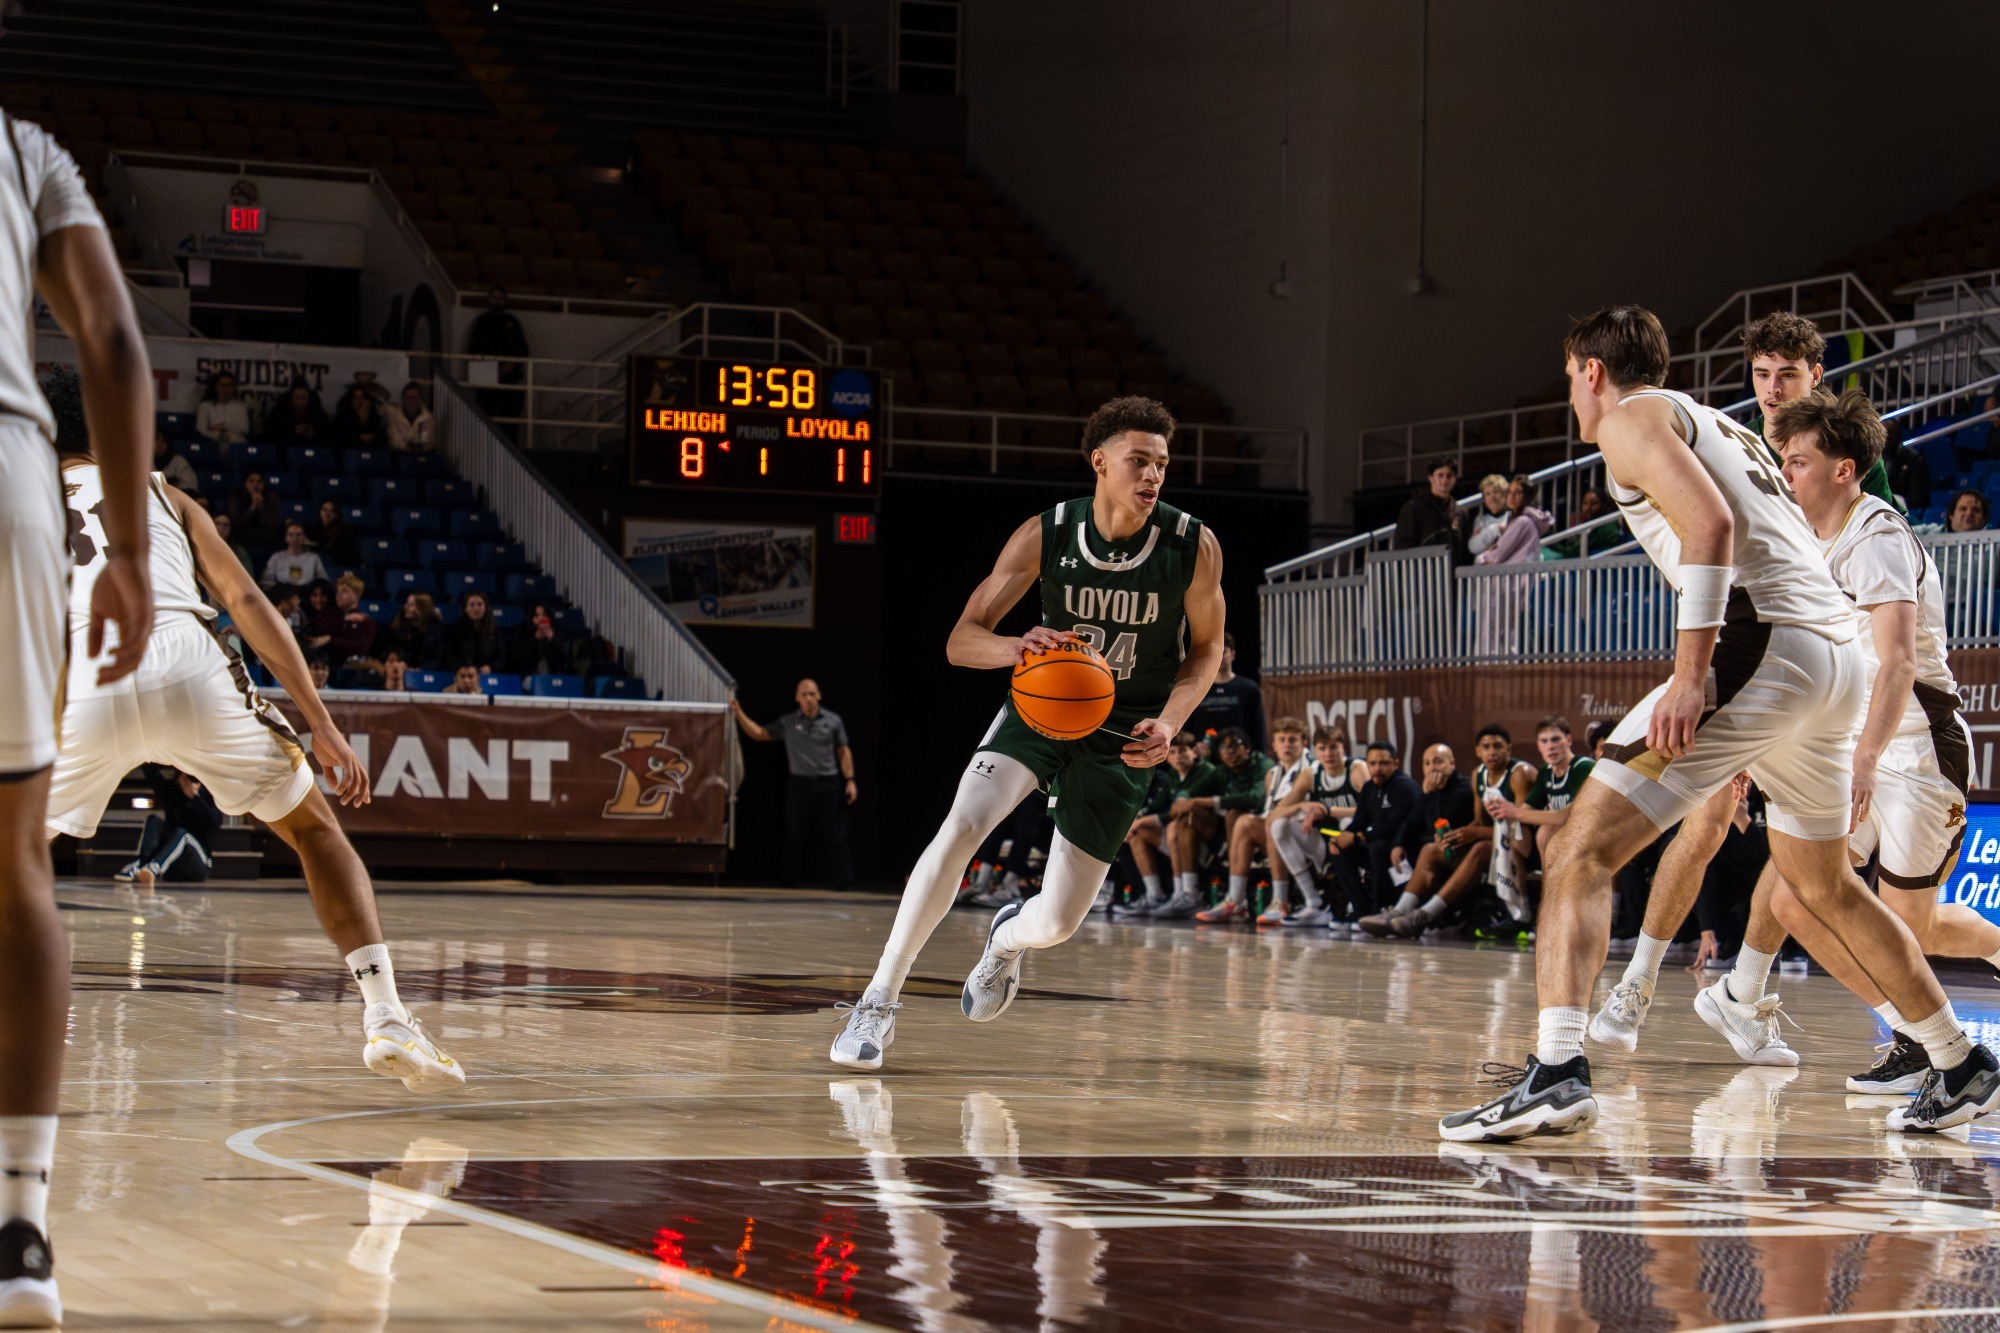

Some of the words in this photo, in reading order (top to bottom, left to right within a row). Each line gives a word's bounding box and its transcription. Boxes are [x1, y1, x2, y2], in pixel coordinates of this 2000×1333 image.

[231, 207, 259, 231] EXIT
[196, 357, 329, 391] STUDENT
[718, 365, 816, 411] 13:58
[645, 408, 727, 434] LEHIGH
[736, 425, 780, 441] PERIOD
[786, 416, 871, 442] LOYOLA
[680, 436, 704, 478] 8
[759, 446, 768, 477] 1
[837, 446, 871, 485] 11
[839, 515, 869, 540] EXIT
[760, 599, 806, 613] VALLEY
[1064, 584, 1159, 625] LOYOLA
[297, 731, 569, 802] IANT
